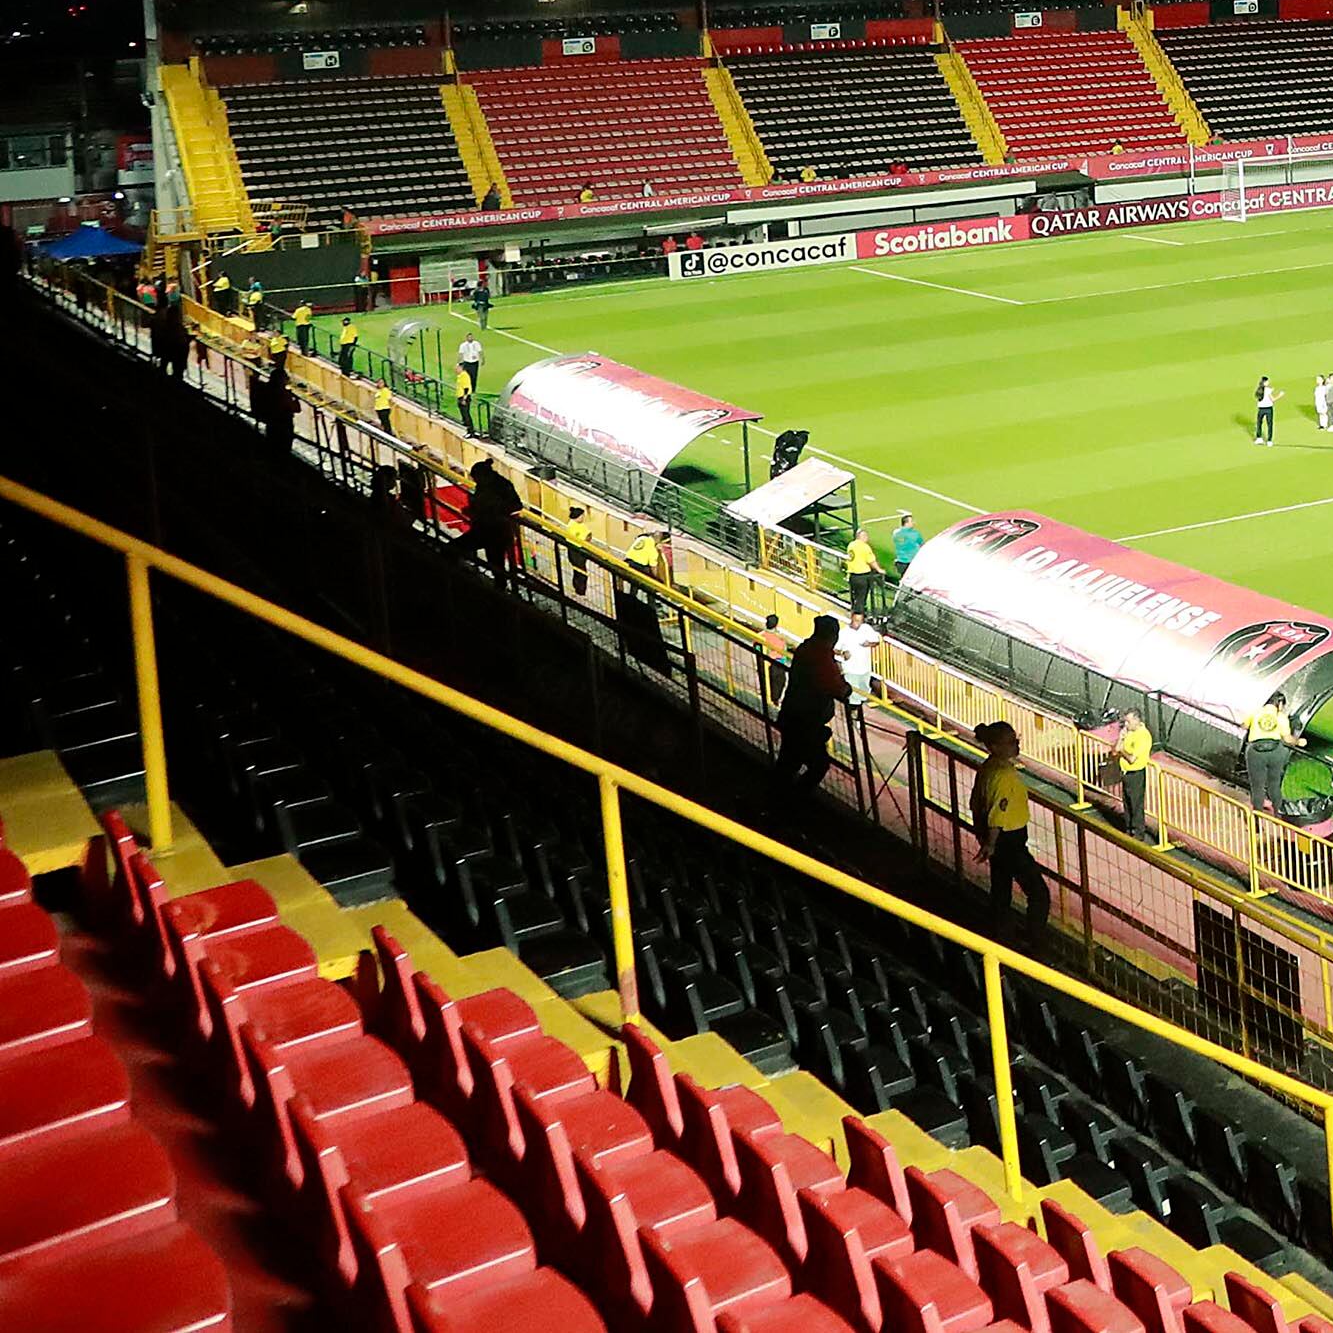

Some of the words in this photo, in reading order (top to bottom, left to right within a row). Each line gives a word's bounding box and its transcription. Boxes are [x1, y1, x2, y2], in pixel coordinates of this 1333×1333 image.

[1109, 160, 1146, 170] Concacaf
[1147, 156, 1187, 167] CENTRAL
[1235, 150, 1253, 159] CUP
[938, 171, 972, 182] Concacaf
[973, 167, 1010, 178] CENTRAL
[1010, 163, 1051, 174] AMERICAN
[1052, 161, 1069, 171] CUP
[762, 186, 799, 198] Concacaf
[799, 183, 839, 194] CENTRAL
[839, 180, 883, 192] AMERICAN
[883, 177, 902, 187] CUP
[580, 203, 620, 214] Concacaf
[620, 198, 662, 211] CENTRAL
[663, 195, 711, 208] AMERICAN
[711, 192, 731, 204] CUP
[421, 216, 466, 229] CENTRAL
[467, 213, 520, 226] AMERICAN
[521, 210, 542, 222] CUP
[1031, 211, 1101, 236] QATAR
[1105, 199, 1190, 226] AIRWAYS
[874, 221, 1014, 256] Scotiabank
[707, 237, 848, 273] @concacaf
